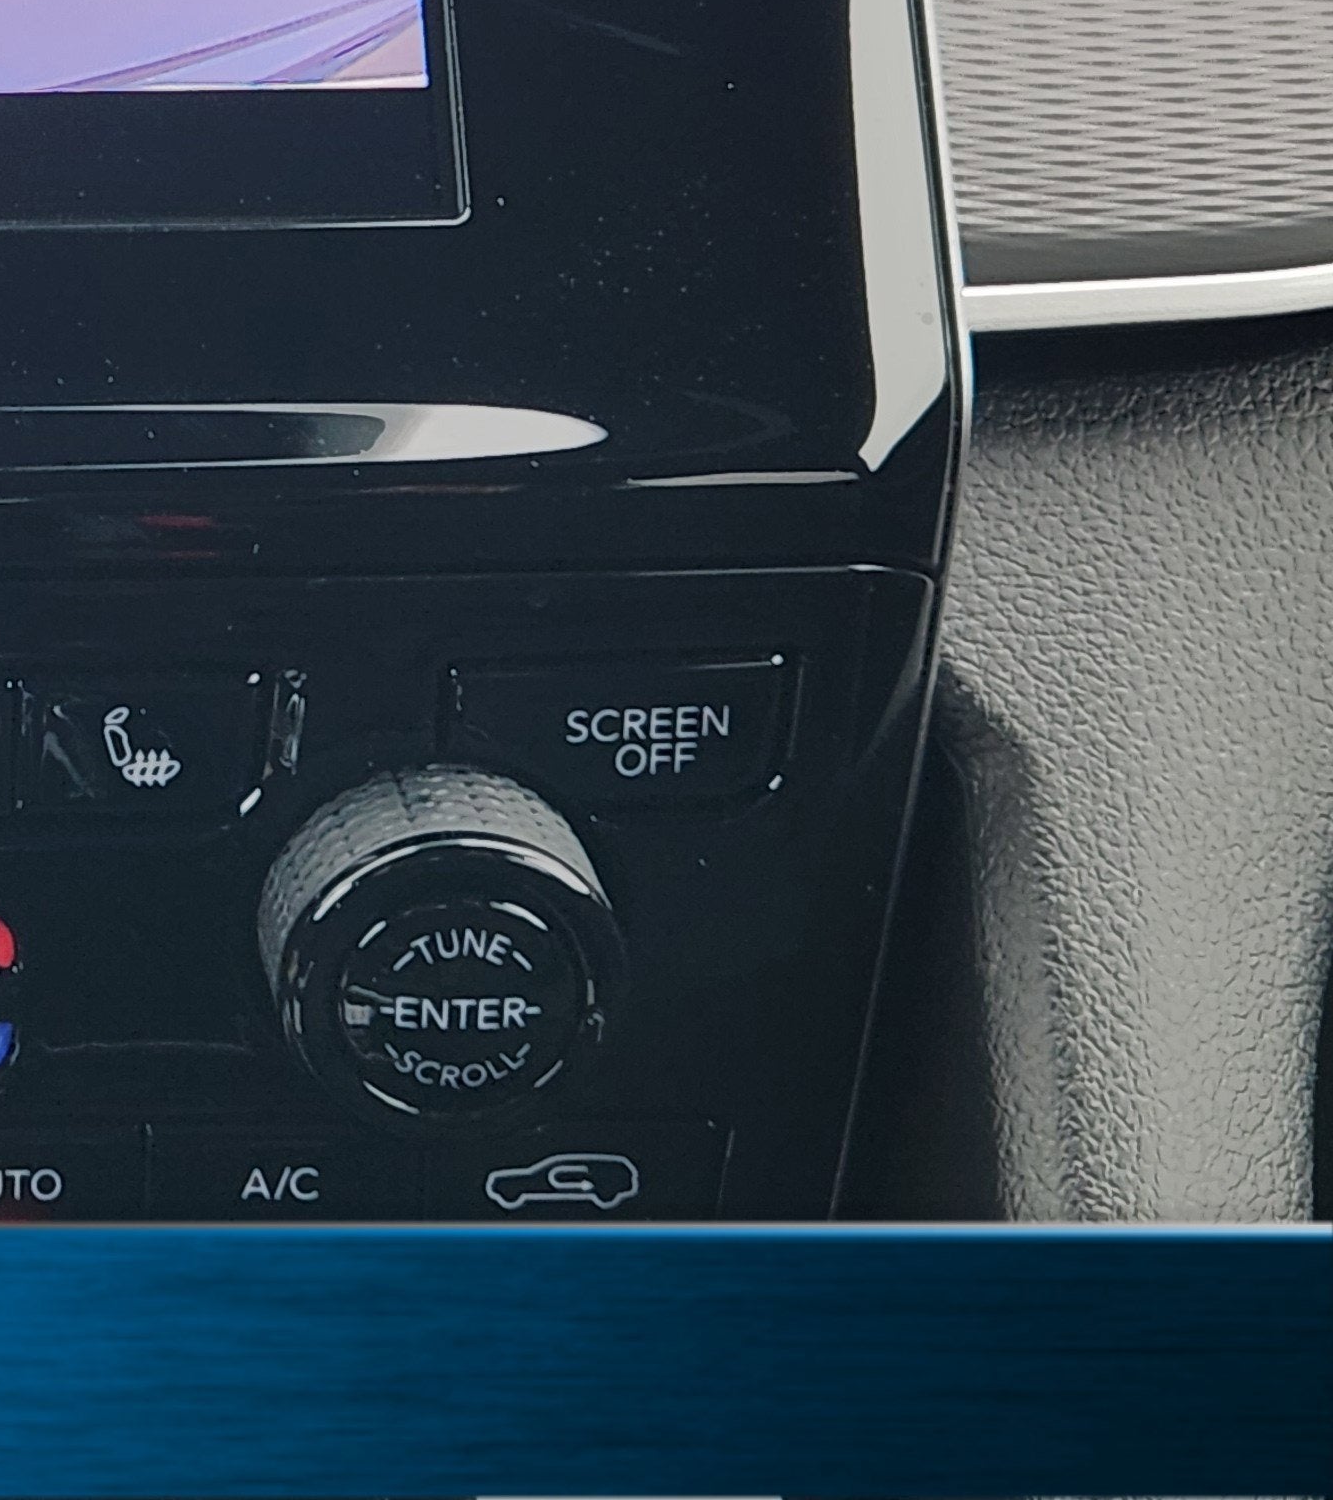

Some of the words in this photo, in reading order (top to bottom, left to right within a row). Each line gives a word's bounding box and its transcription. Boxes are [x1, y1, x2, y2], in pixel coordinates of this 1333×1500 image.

[565, 704, 731, 744] SCREEN
[614, 743, 698, 777] OFF
[410, 928, 512, 966] TUNE
[394, 996, 527, 1030] ENTER
[394, 1050, 526, 1090] SCROLL
[240, 1166, 320, 1201] A/C
